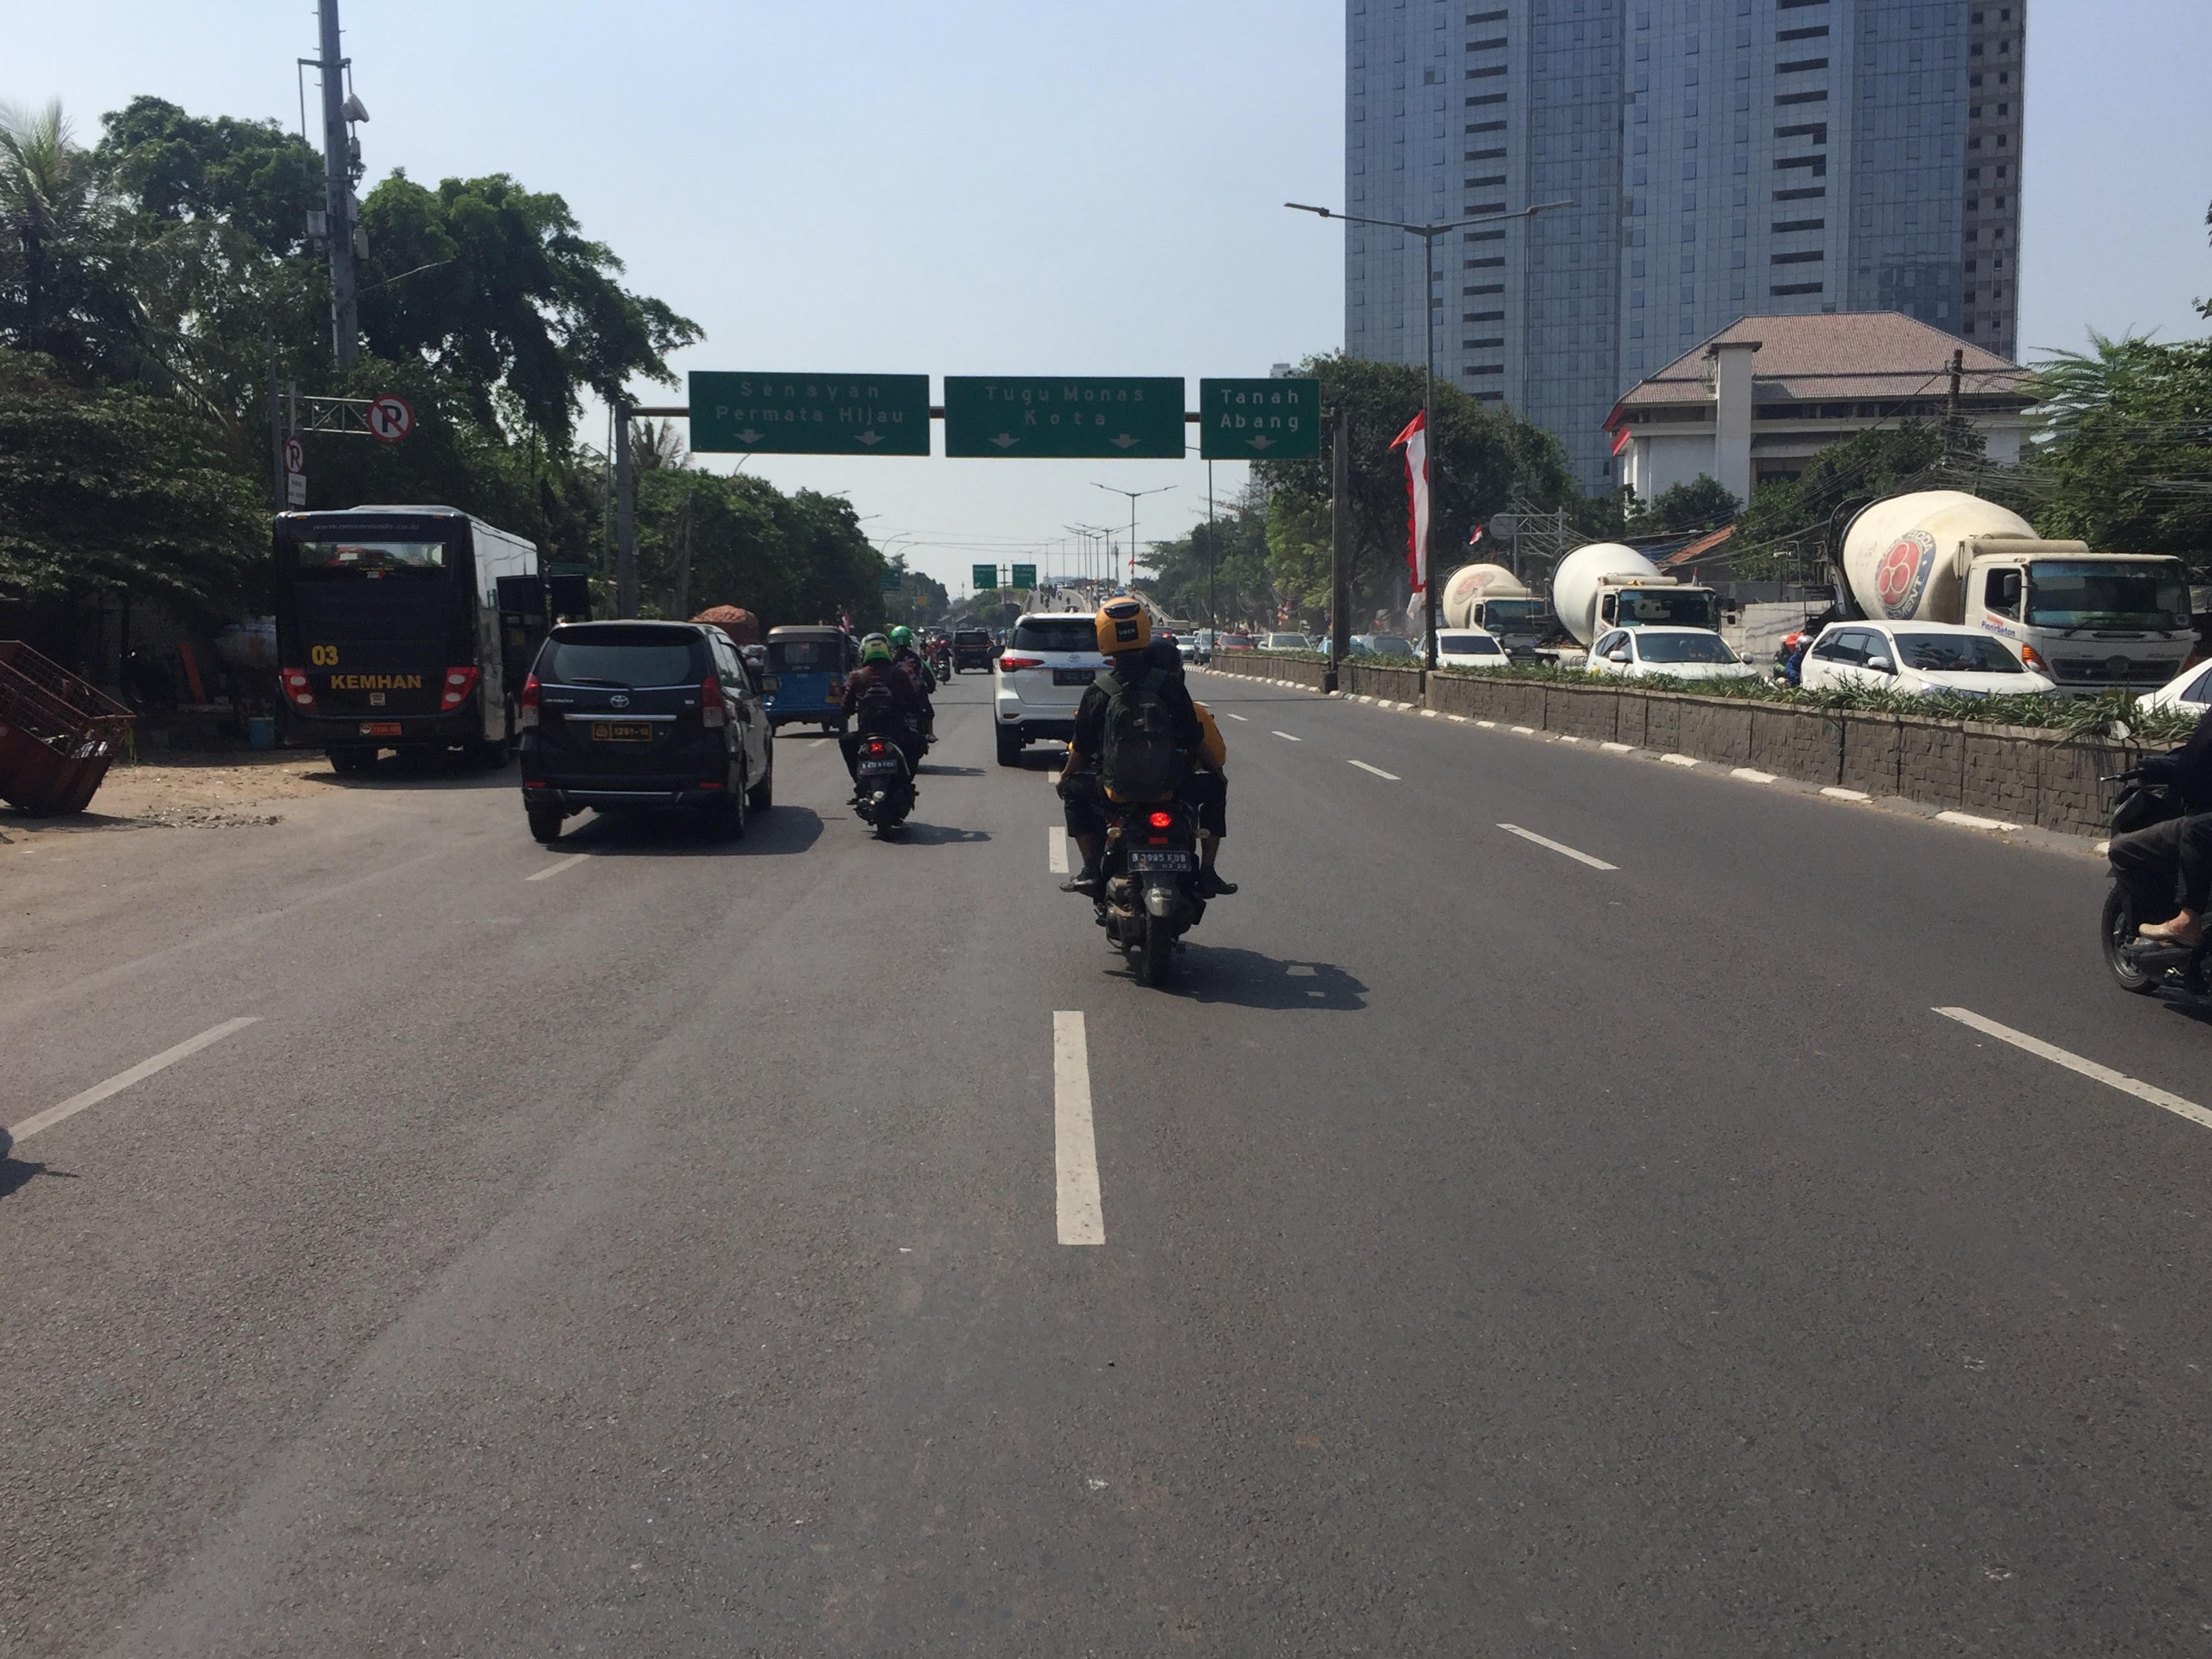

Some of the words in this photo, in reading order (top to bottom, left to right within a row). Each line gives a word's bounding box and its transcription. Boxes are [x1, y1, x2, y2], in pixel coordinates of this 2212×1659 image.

[740, 381, 880, 401] Senayan
[986, 385, 1050, 405] Tugu
[1064, 386, 1144, 402] Monas
[1220, 389, 1299, 405] Tanah
[715, 404, 824, 423] Permata
[840, 407, 904, 426] Hijau
[1025, 409, 1106, 426] Kota
[1220, 413, 1299, 433] Abang
[311, 644, 339, 666] 03
[330, 674, 422, 690] KEMHAN
[1132, 853, 1139, 862] B
